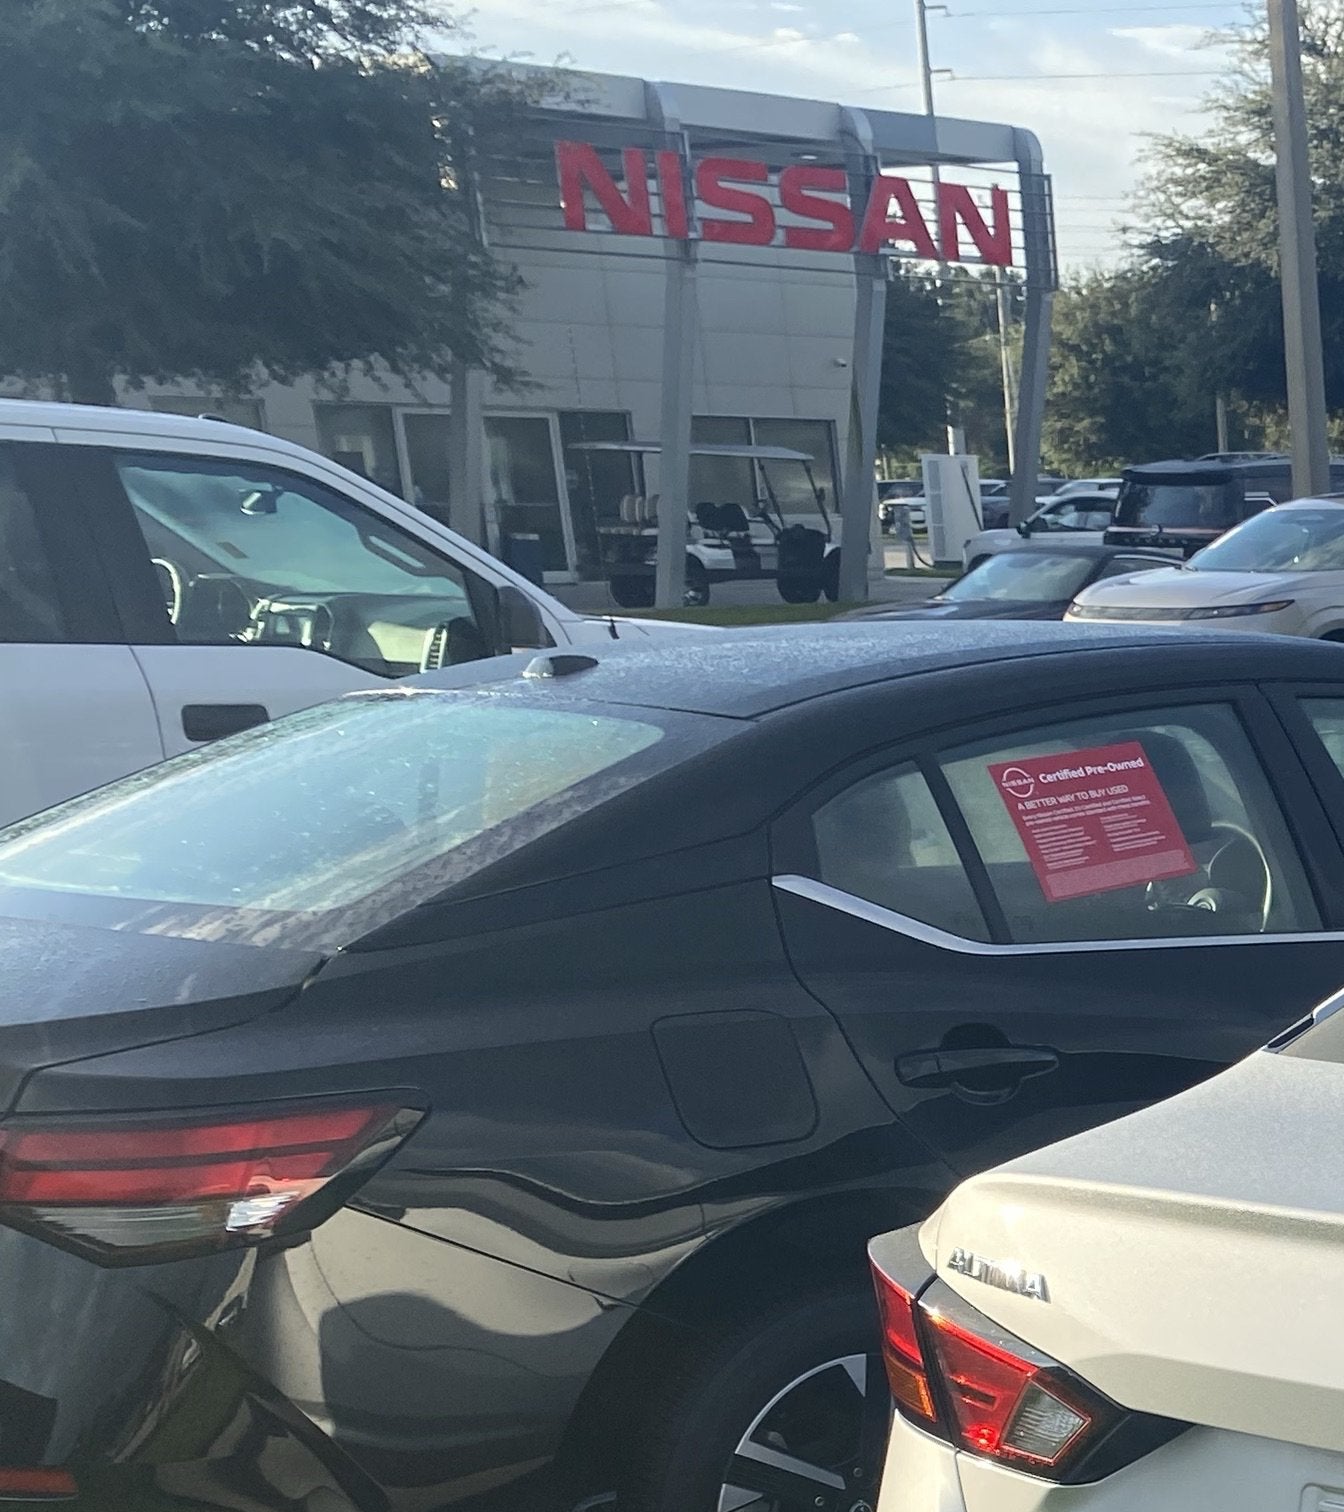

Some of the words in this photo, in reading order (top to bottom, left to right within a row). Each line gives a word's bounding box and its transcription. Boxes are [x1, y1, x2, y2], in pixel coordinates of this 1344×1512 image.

[553, 139, 1014, 268] NISSAN
[1002, 776, 1035, 789] NISSAN
[1038, 768, 1085, 784] Certified
[1087, 757, 1145, 776] Pre-Owned
[1017, 802, 1026, 811] A
[1024, 796, 1058, 810] BETTER
[1057, 792, 1076, 805] WAY
[1075, 791, 1089, 801] TO
[1087, 788, 1106, 799] BUY
[1106, 784, 1129, 796] USED
